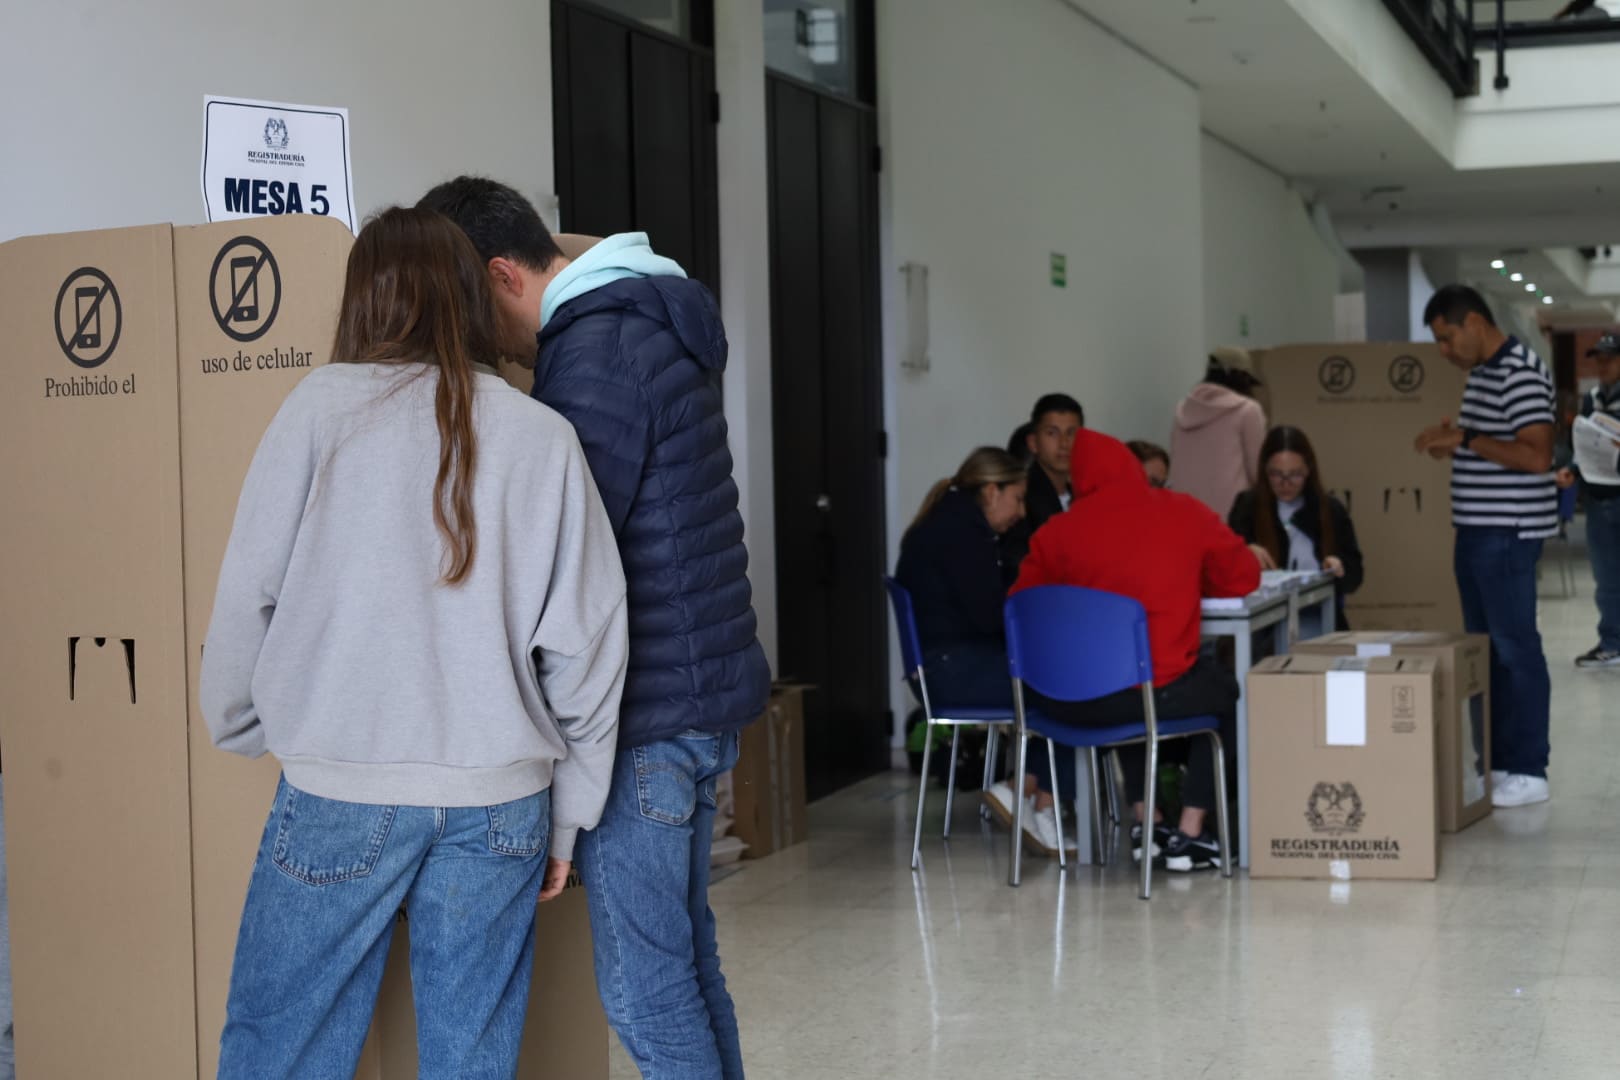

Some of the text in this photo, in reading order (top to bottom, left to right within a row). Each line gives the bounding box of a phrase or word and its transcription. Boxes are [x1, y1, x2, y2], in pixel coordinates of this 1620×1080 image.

[247, 150, 305, 162] REGISTRADURÍA
[224, 177, 330, 216] MESA 5
[201, 346, 313, 373] uso de celular
[45, 373, 136, 397] Prohibido el
[1270, 836, 1400, 851] REGISTRADURÍA
